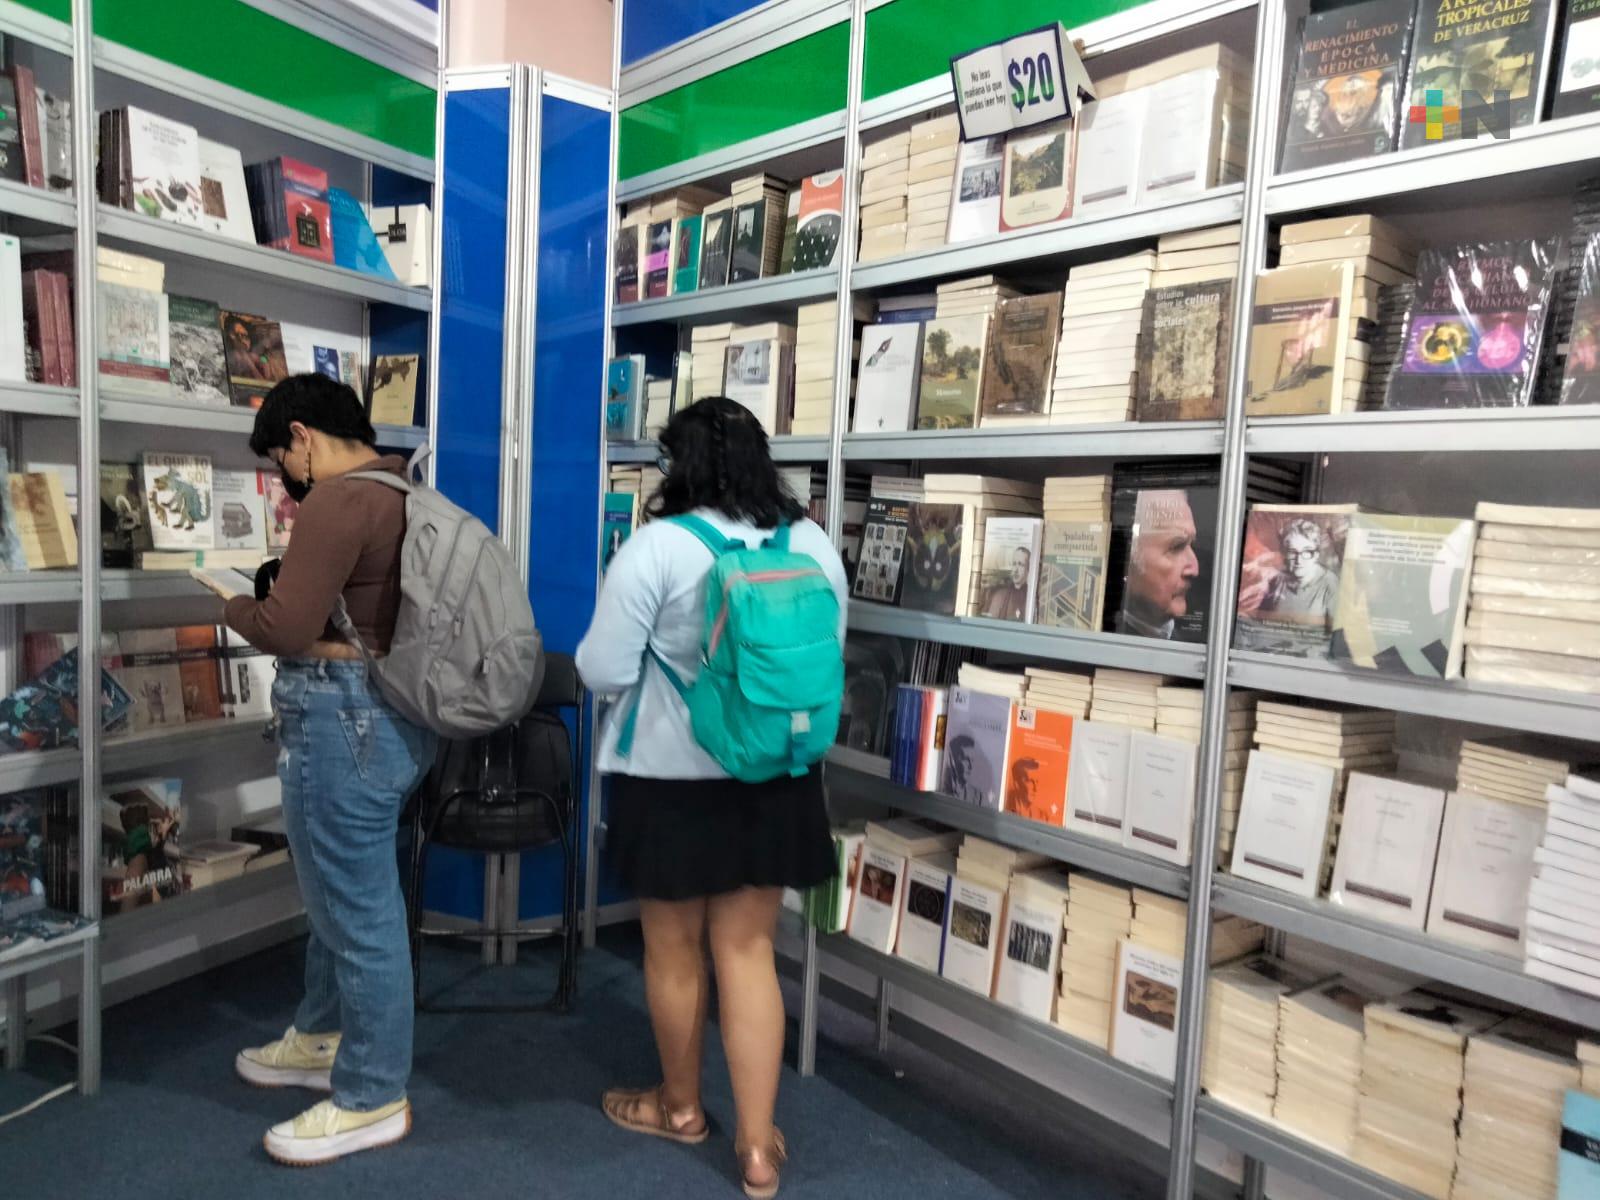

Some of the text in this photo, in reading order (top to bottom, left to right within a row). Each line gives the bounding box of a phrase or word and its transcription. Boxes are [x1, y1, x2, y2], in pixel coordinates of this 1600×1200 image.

[1346, 19, 1359, 29] EL
[1437, 0, 1532, 27] TROPICALES
[1305, 23, 1399, 52] RENACIMIENTO
[1434, 10, 1531, 43] DE VERACRUZ
[970, 71, 979, 82] No
[1304, 53, 1390, 78] Y MEDICINA
[964, 86, 986, 99] mañana
[992, 81, 1003, 94] que
[1007, 52, 1055, 114] $20
[984, 97, 996, 108] leer
[995, 94, 1007, 106] hoy
[1185, 293, 1220, 306] cultura
[123, 867, 172, 893] PALABRA
